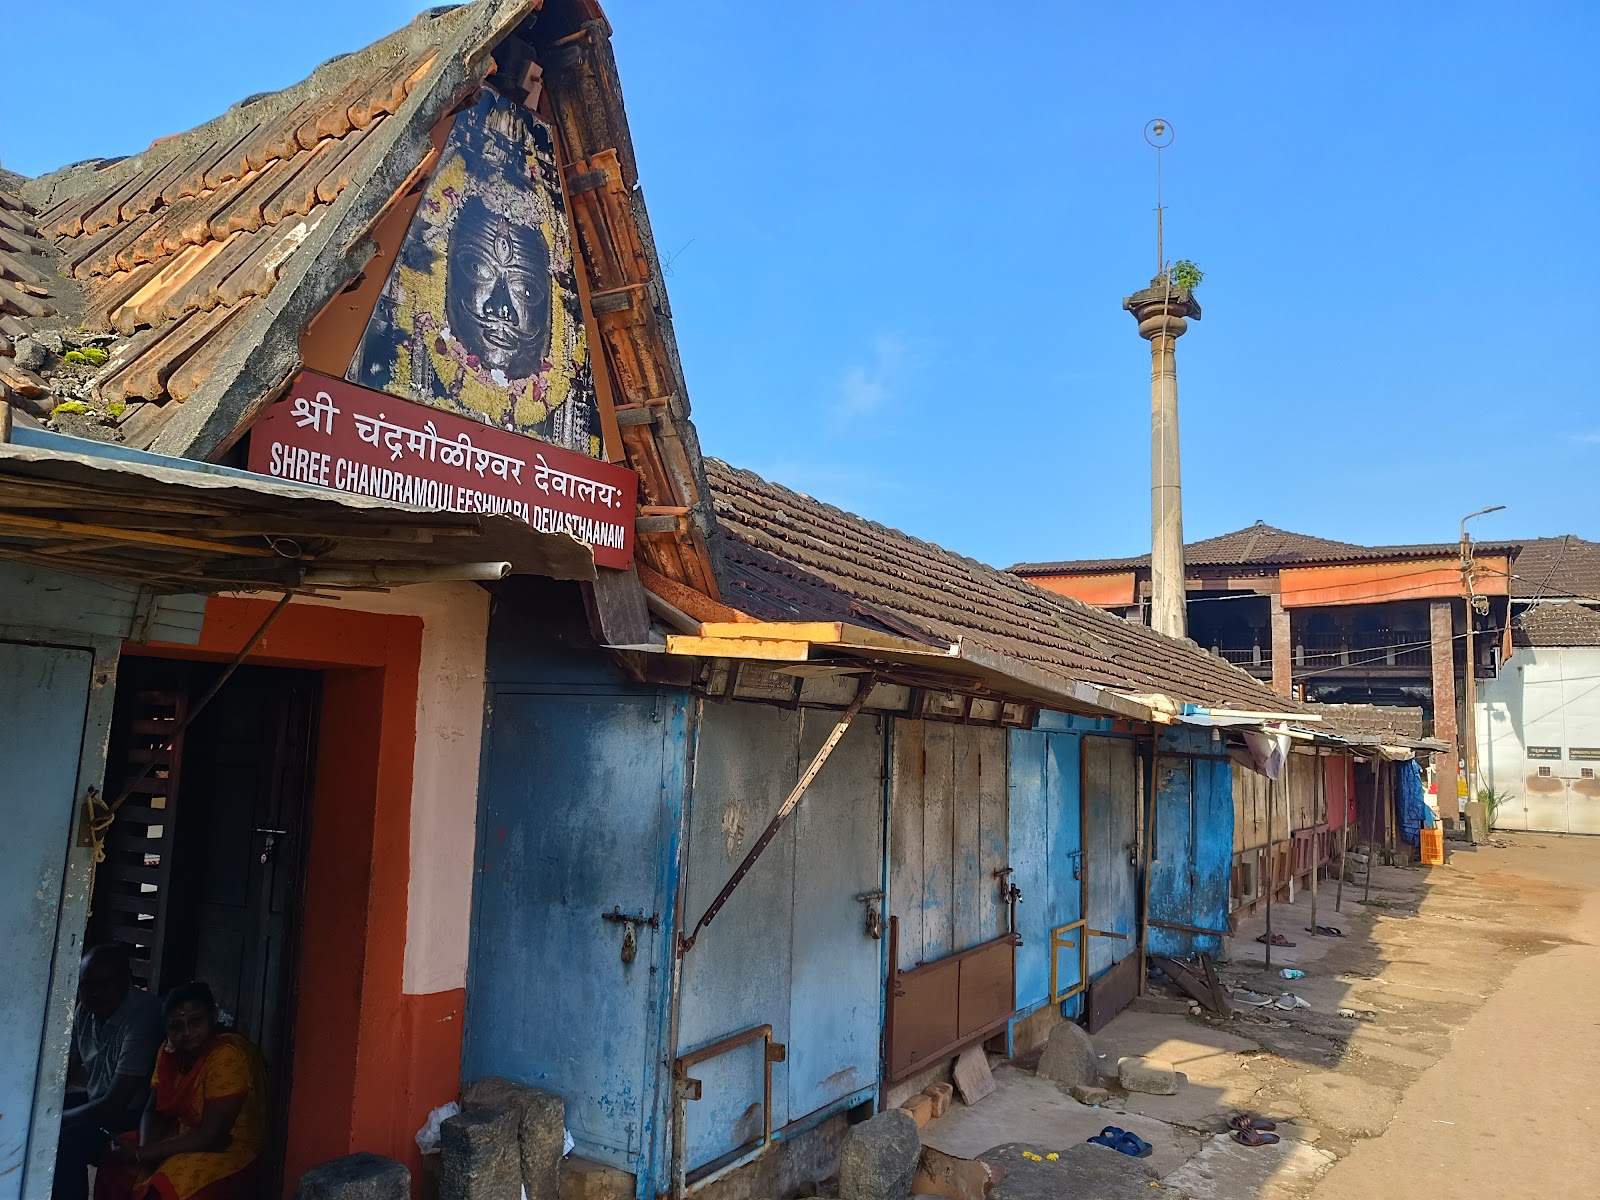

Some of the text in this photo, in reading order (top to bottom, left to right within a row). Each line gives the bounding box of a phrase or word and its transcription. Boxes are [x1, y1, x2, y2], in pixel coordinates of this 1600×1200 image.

[290, 391, 341, 435] श्री
[353, 412, 526, 485] चंद्रमौळीश्वर
[269, 441, 331, 487] SHREE
[533, 505, 625, 550] DEVASTHAANAM
